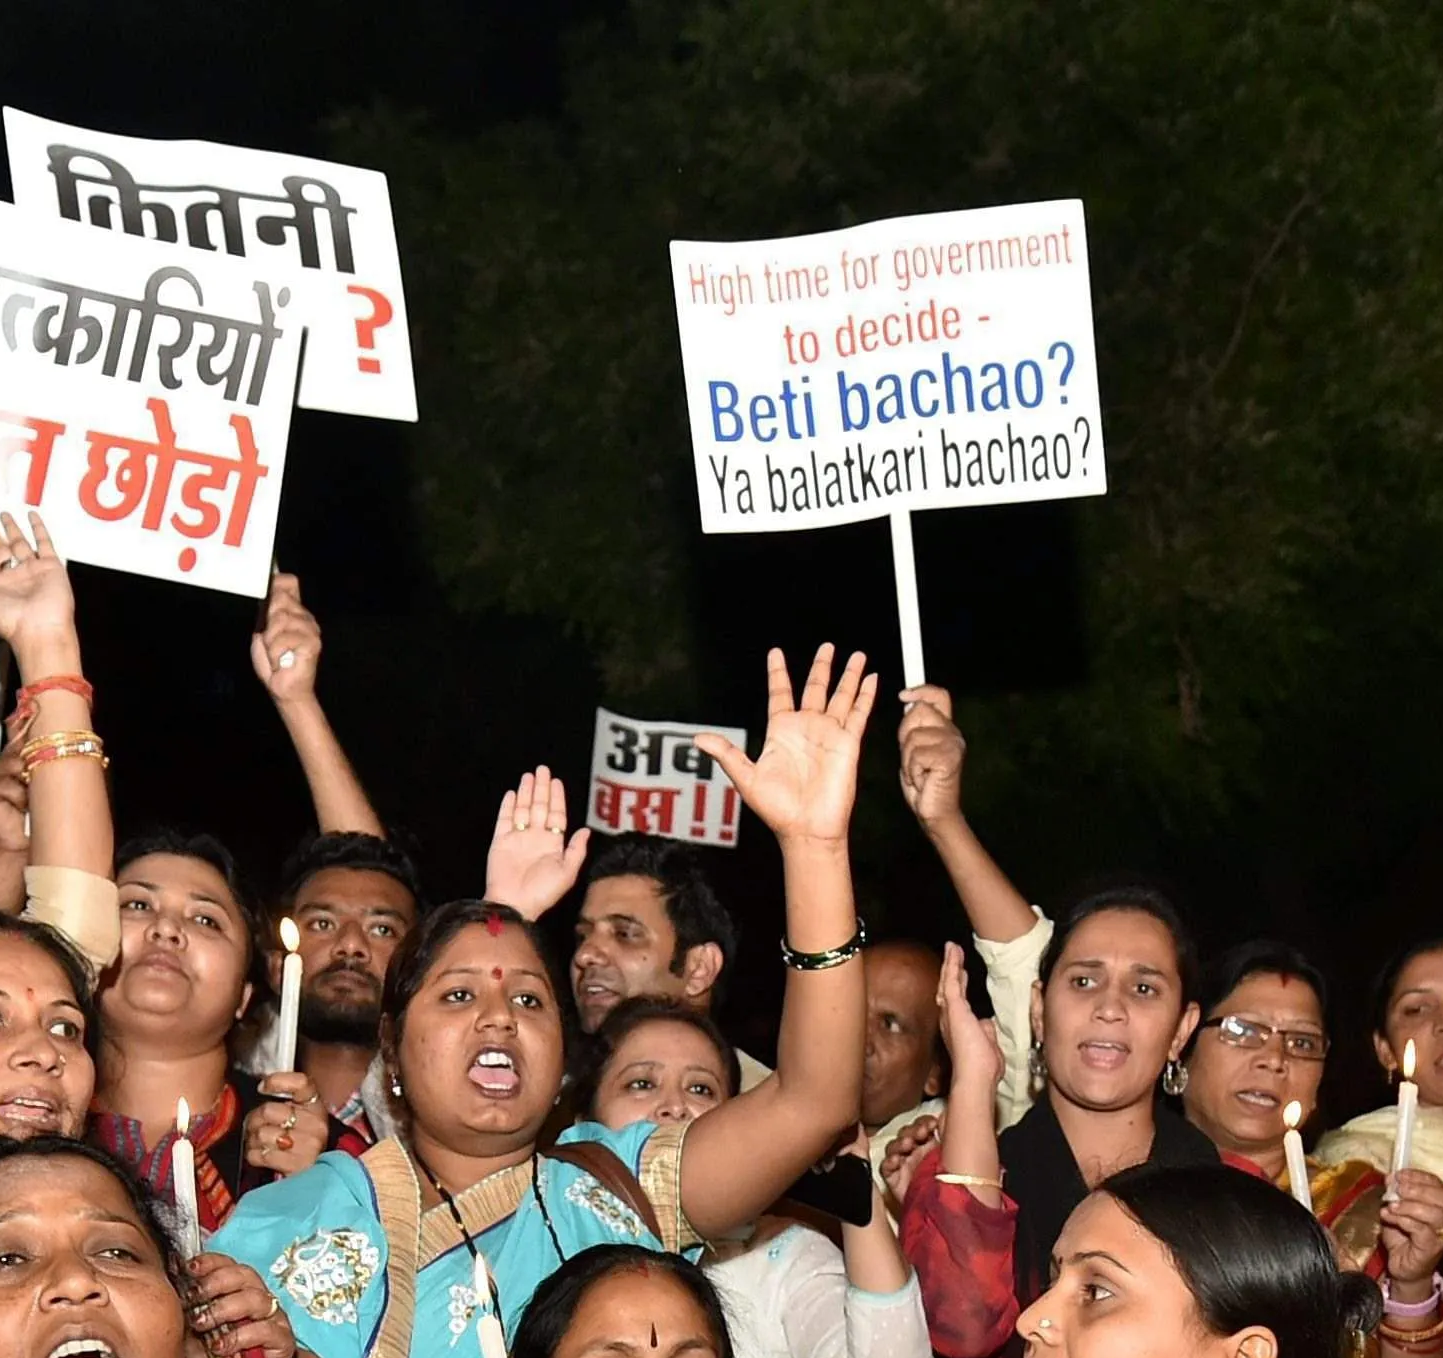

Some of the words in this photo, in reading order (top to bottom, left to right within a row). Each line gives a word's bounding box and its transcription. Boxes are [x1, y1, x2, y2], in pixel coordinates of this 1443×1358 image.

[688, 263, 753, 316] High
[764, 260, 829, 303] time
[841, 249, 880, 292] for
[893, 224, 1073, 291] government
[783, 325, 820, 366] to
[835, 298, 961, 358] decide
[708, 375, 817, 443] Beti
[836, 341, 1076, 432] bachao?
[76, 397, 269, 573] छोड़ो
[709, 454, 754, 515] Ya
[765, 430, 929, 514] balatkari
[940, 416, 1092, 489] bachao?
[606, 722, 713, 781] अब
